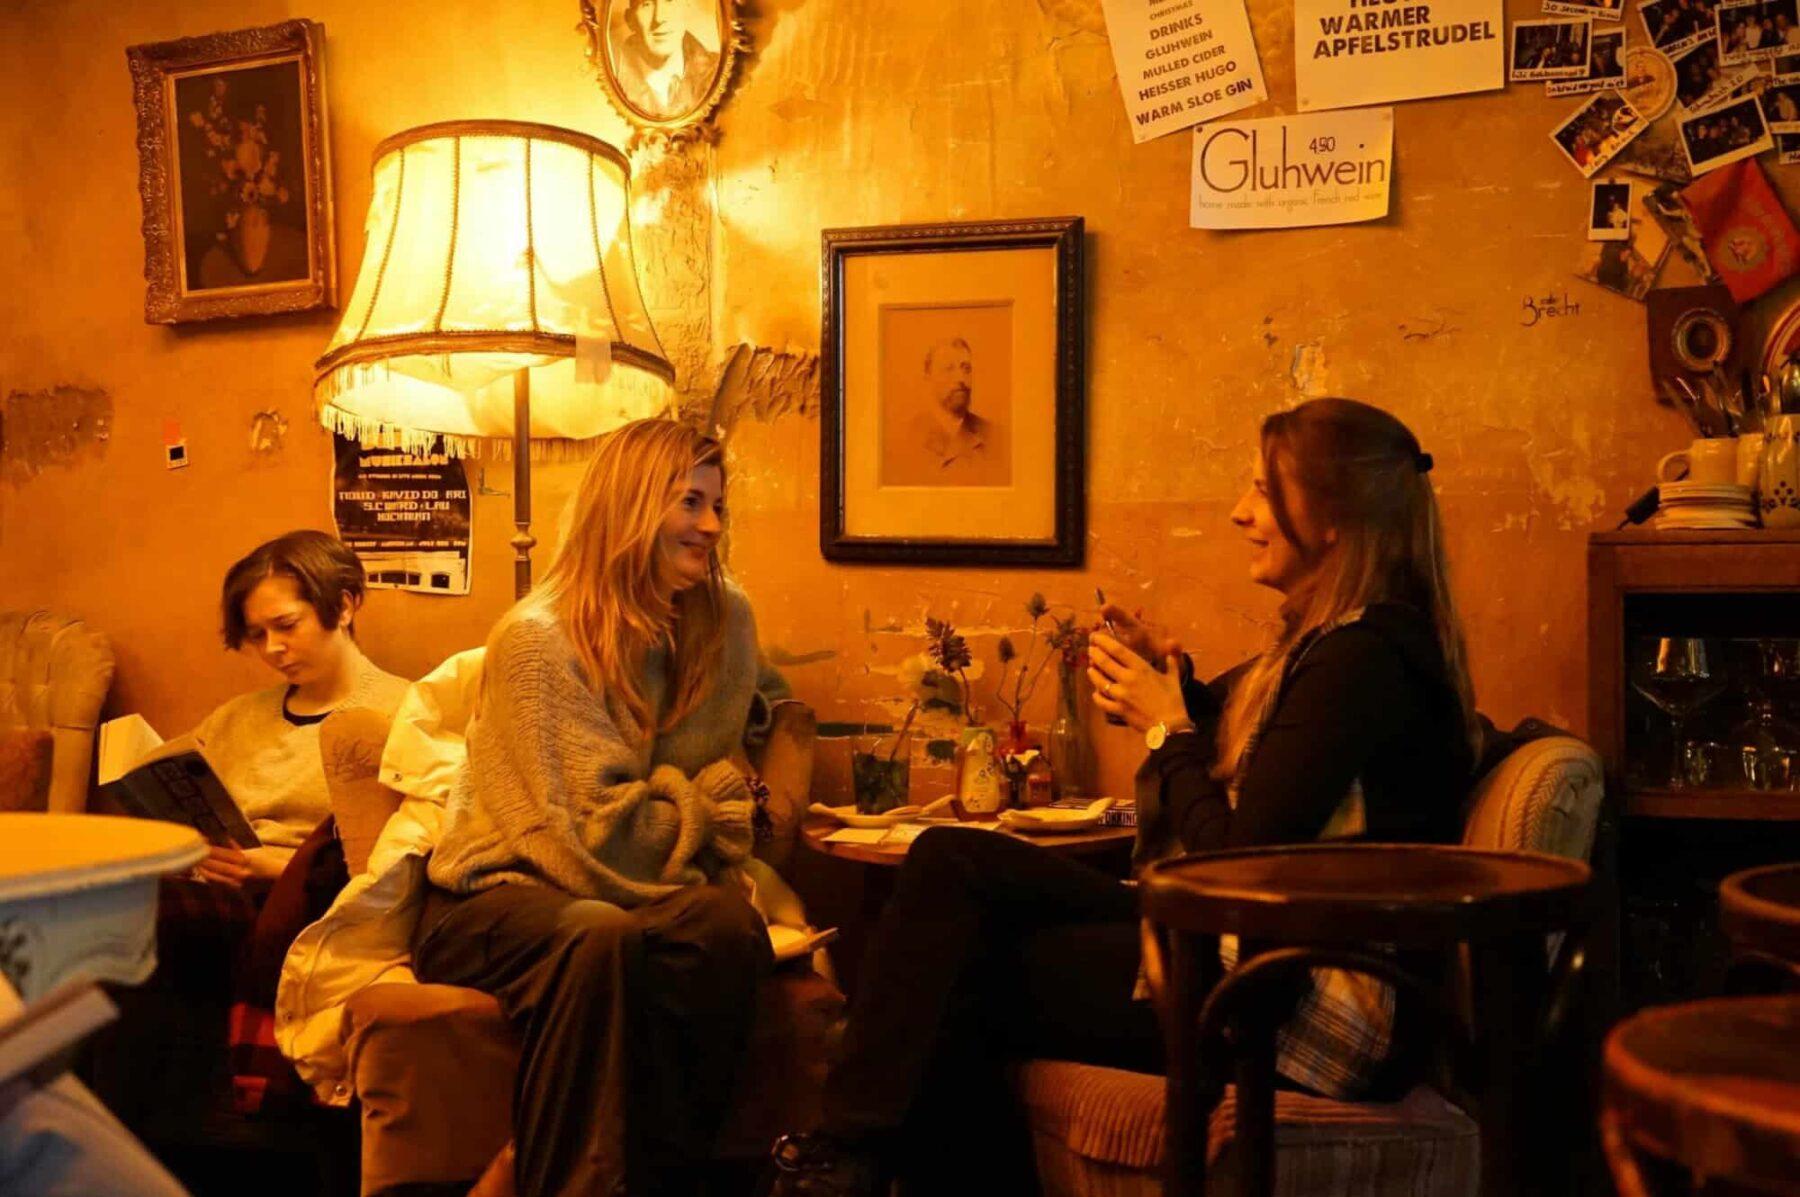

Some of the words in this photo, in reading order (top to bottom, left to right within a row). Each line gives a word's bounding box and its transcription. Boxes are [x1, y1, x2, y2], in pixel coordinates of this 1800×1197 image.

[1149, 12, 1203, 41] DRINKS
[1319, 5, 1431, 36] WARMER
[1145, 29, 1214, 60] GLUHWEIN
[1313, 20, 1496, 60] APFELSTRUDEL
[1138, 76, 1192, 101] HEISSER
[1194, 60, 1237, 83] HUGO
[1143, 57, 1190, 80] MULLED
[1192, 44, 1226, 64] CIDER
[1136, 101, 1184, 126] WARM
[1187, 89, 1223, 109] SLOE
[1225, 78, 1253, 97] GIN
[1200, 125, 1386, 193] Gluhwein
